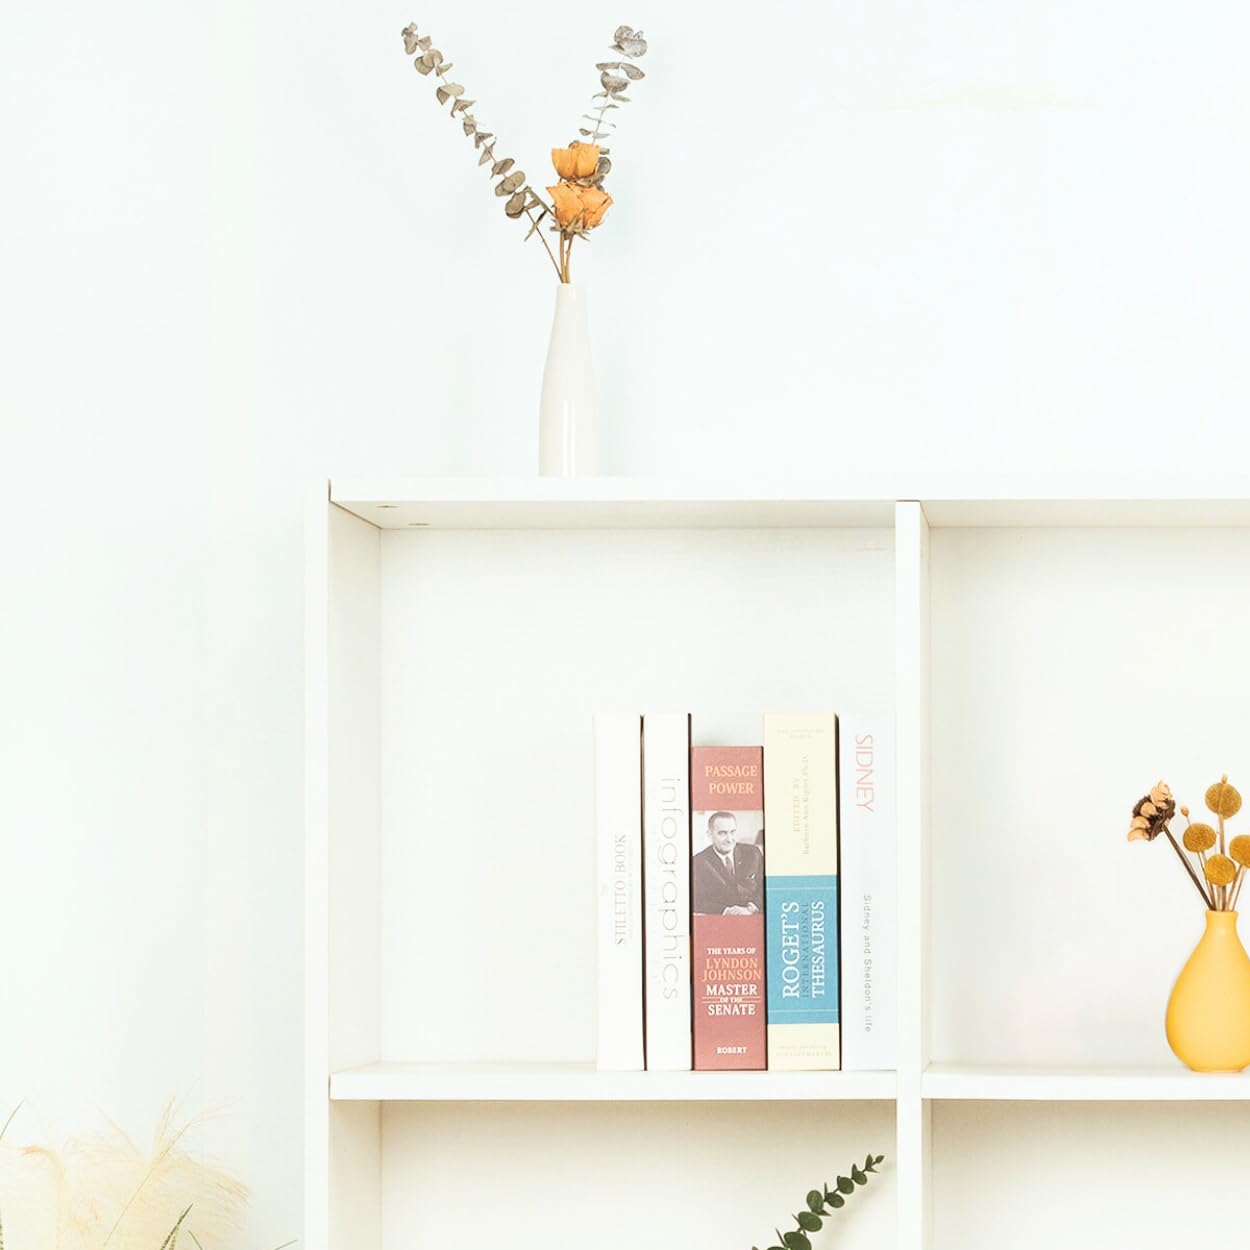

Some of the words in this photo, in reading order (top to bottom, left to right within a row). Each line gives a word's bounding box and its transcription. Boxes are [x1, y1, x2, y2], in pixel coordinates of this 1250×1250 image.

[705, 765, 758, 777] PASSAGE
[856, 735, 874, 812] SIDNEY
[708, 782, 755, 795] POWER
[615, 834, 626, 871] BOOK
[658, 778, 684, 1000] infographics
[863, 894, 873, 930] Sidney
[707, 947, 721, 955] THE
[722, 947, 743, 955] YEARS
[744, 947, 757, 955] OF
[782, 901, 801, 999] ROGET'S
[802, 902, 810, 998] INTERNATIONAL
[810, 900, 825, 998] THESAURUS
[863, 934, 873, 954] and
[706, 957, 759, 969] LYNDON
[702, 969, 762, 982] JOHNSON
[863, 958, 873, 1011] Sheldon's
[706, 984, 758, 996] MASTER
[707, 1004, 756, 1015] SENATE
[864, 1015, 873, 1032] life
[716, 1045, 747, 1053] ROBERT
